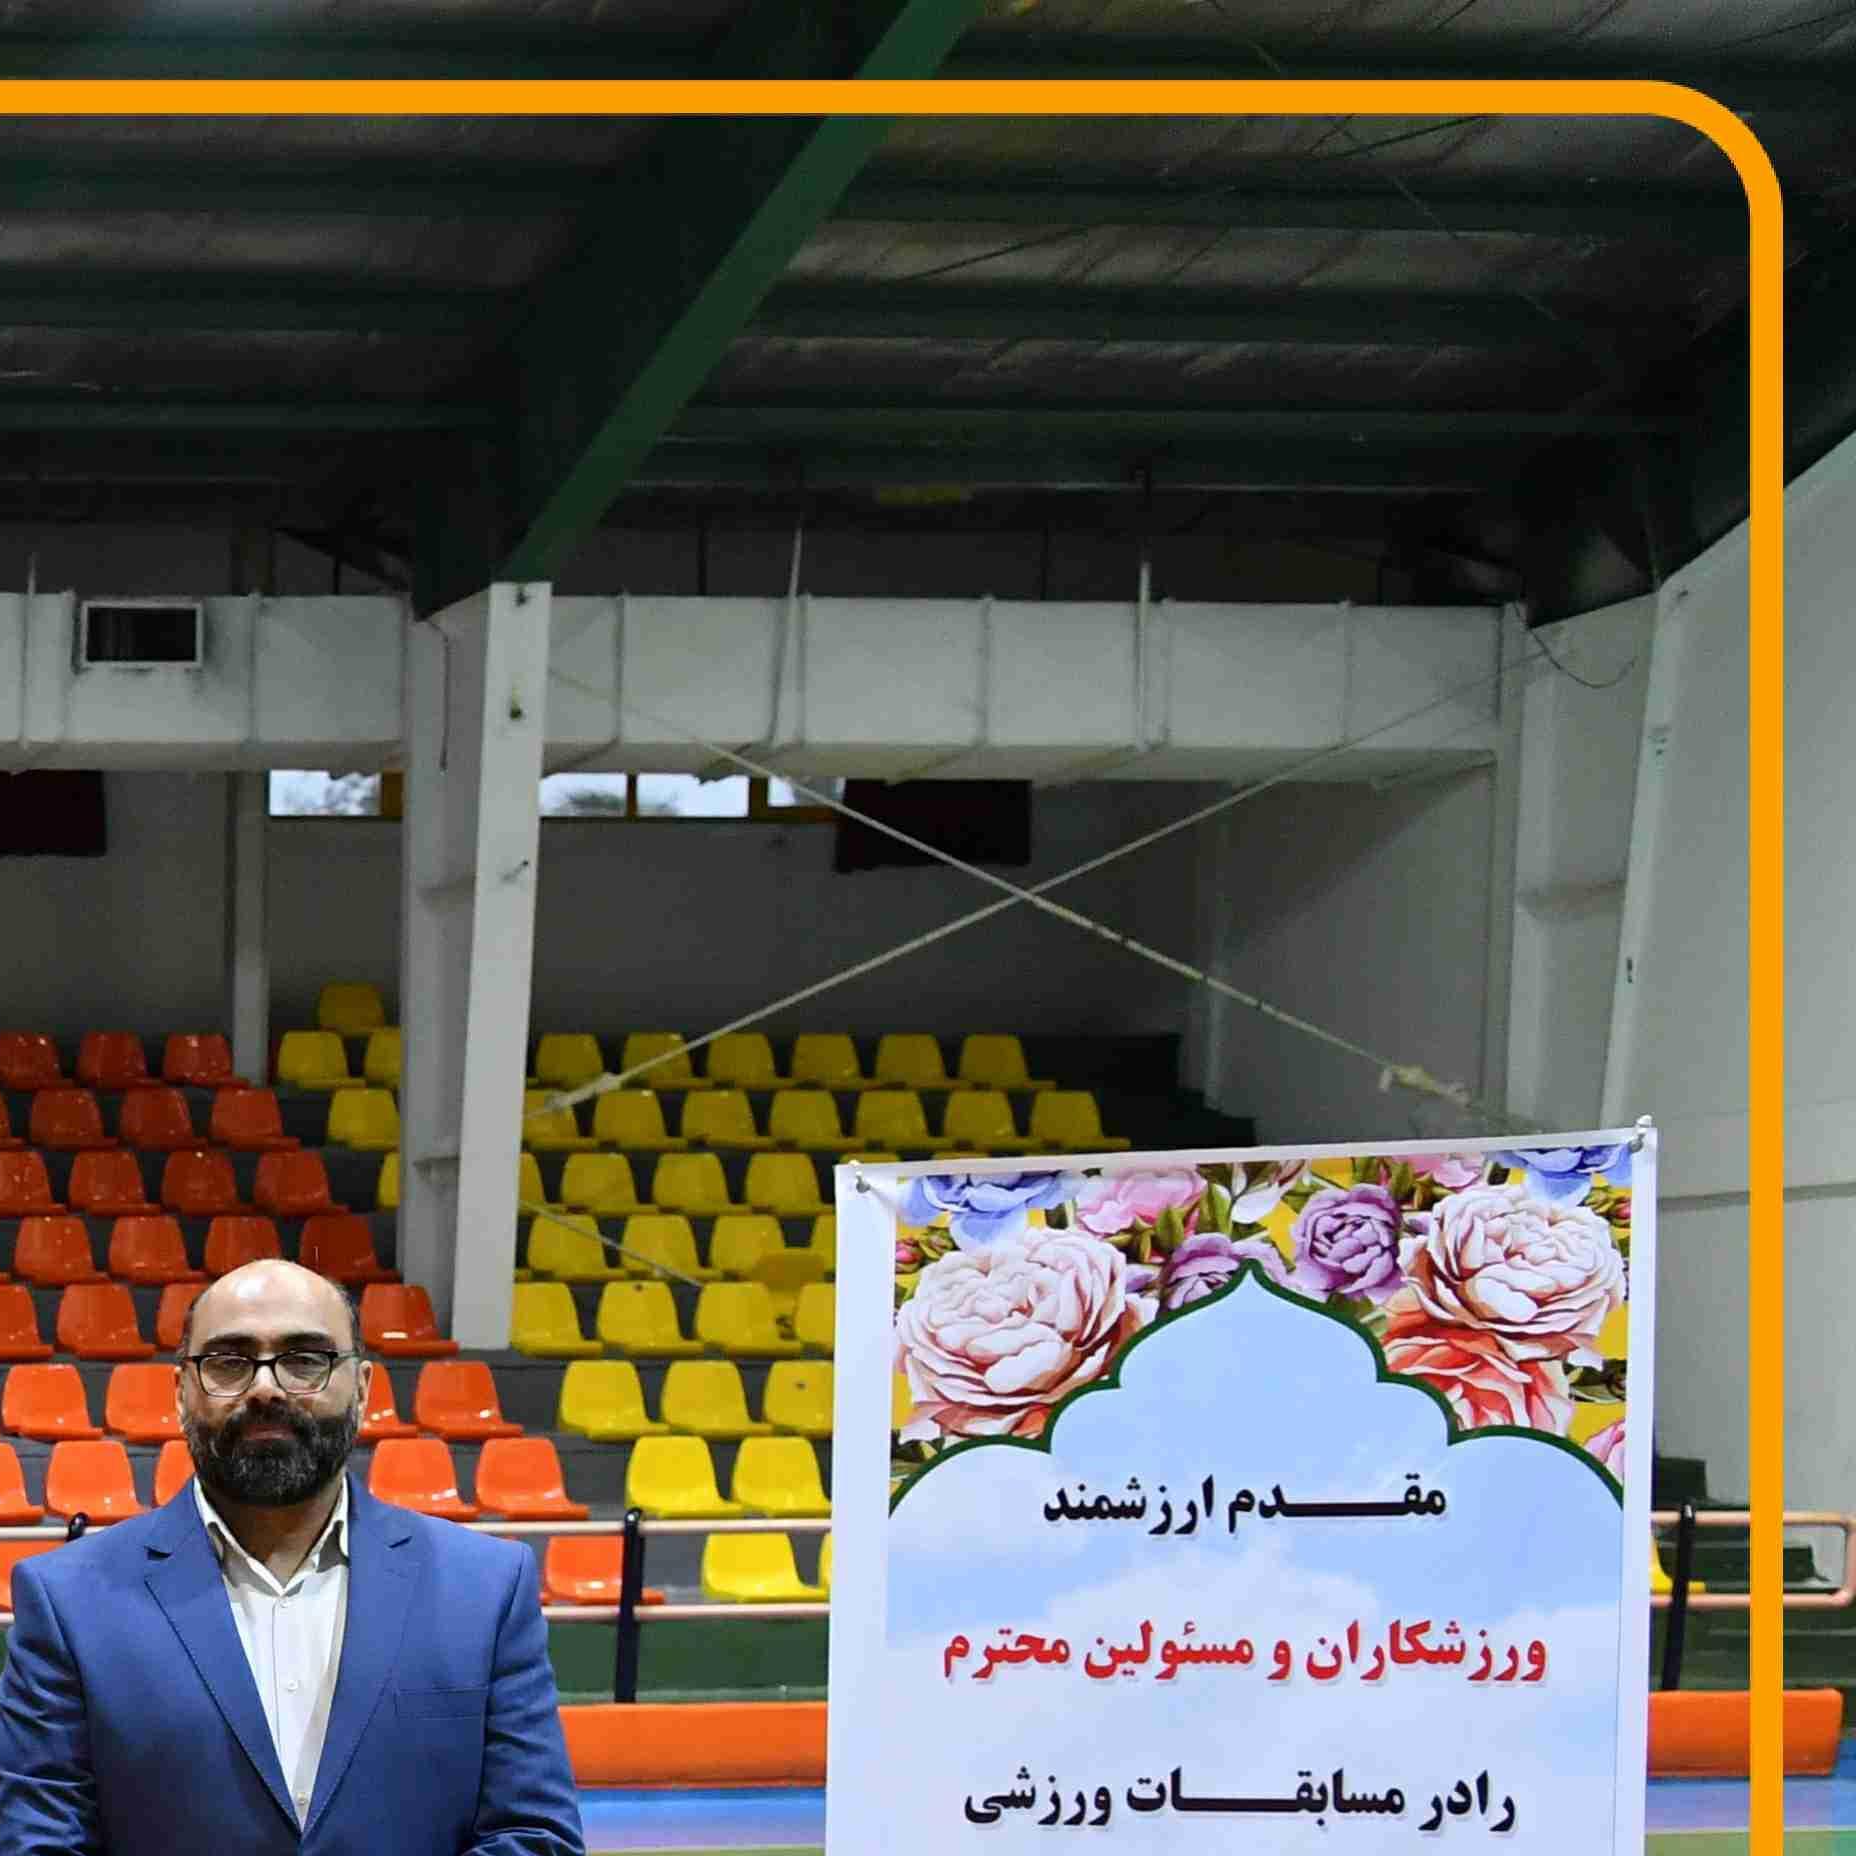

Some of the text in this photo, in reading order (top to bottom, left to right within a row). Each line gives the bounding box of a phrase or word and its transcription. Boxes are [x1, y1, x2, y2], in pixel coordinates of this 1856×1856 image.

[1044, 1474, 1446, 1535] مقدم ارزشمند
[943, 1620, 1547, 1681] ورزشکاران و مسئولین محترم
[964, 1767, 1111, 1826] ورزشی
[1126, 1767, 1405, 1826] مسابقات
